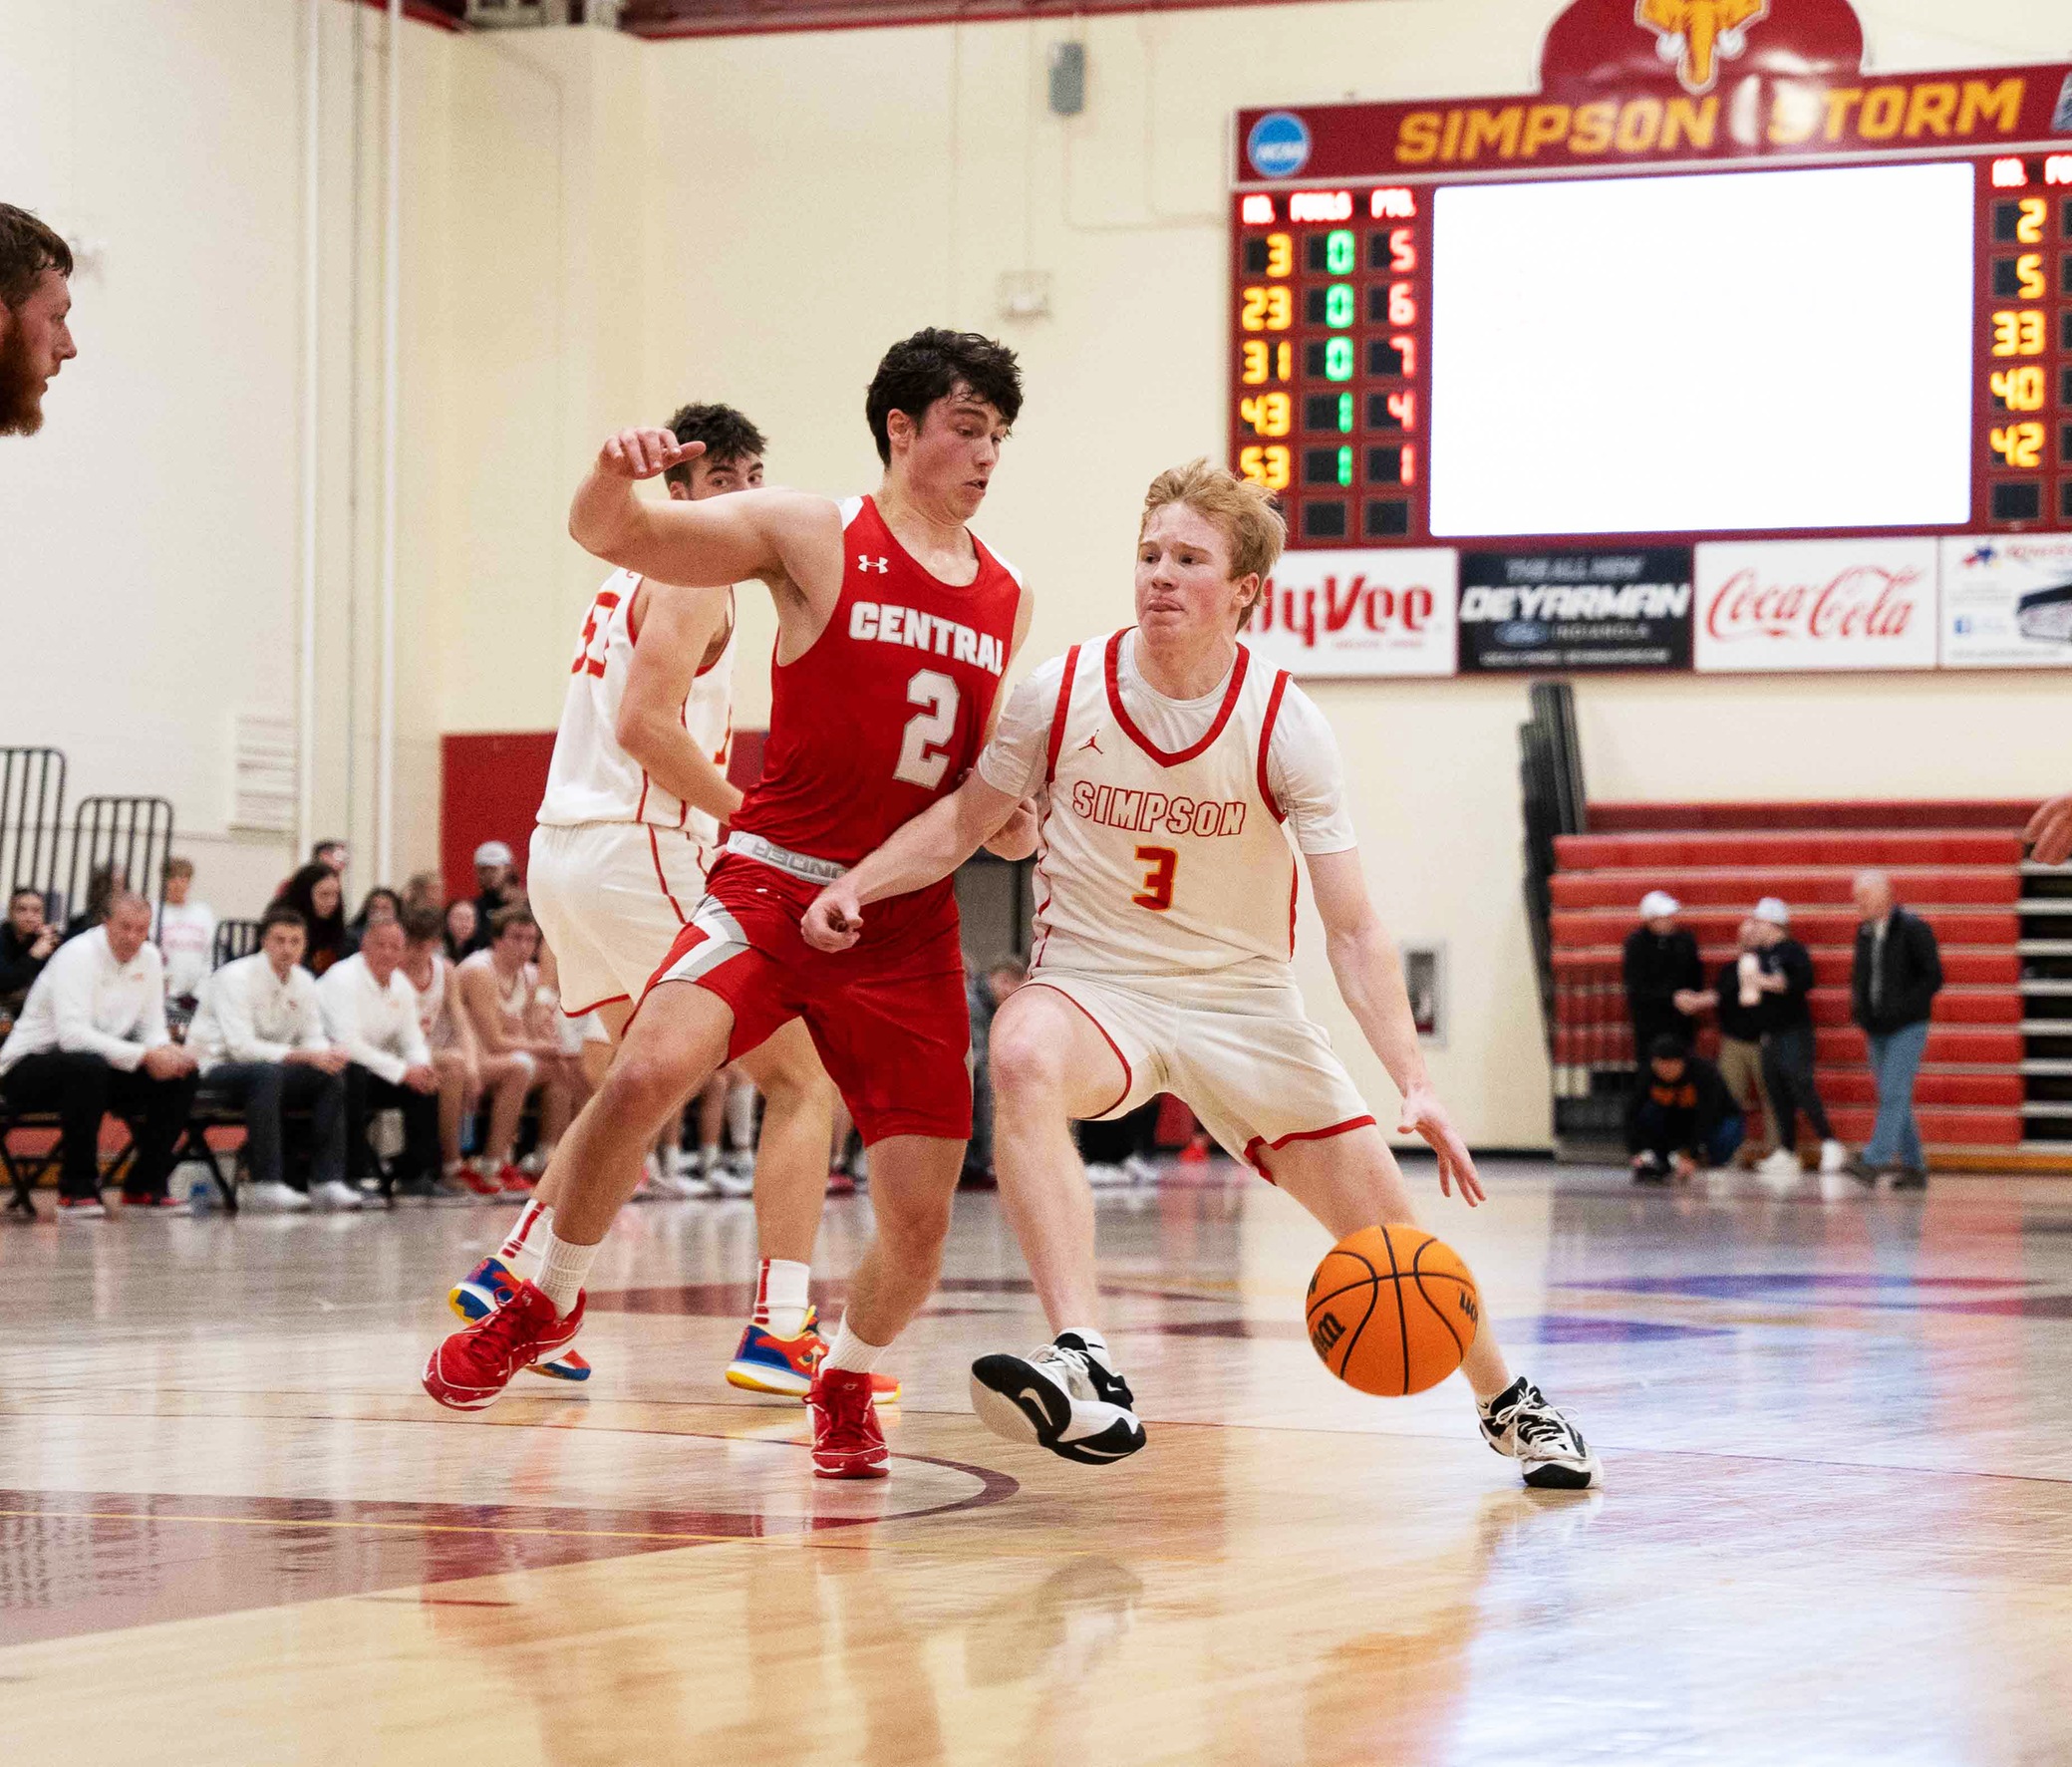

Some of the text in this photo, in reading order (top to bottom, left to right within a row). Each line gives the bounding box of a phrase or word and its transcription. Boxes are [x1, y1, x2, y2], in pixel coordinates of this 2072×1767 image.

[1396, 79, 2024, 163] SIMPSON STORM
[2016, 197, 2046, 243] 2
[1266, 226, 1417, 277] 3 0 5
[2016, 253, 2045, 299] 5
[1241, 281, 1417, 331] 23 0 6
[1991, 309, 2046, 357] 33
[1242, 335, 1417, 385] 31 0 7
[1989, 366, 2045, 412] 40
[1240, 392, 1416, 437] 43 1 4
[1240, 443, 1416, 489] 53 1 1
[1989, 422, 2045, 468] 42
[1459, 583, 1691, 622] DEYARMAN
[848, 601, 1004, 677] CENTRAL
[892, 668, 960, 791] 2
[1072, 780, 1246, 837] SIMPSON
[1131, 845, 1178, 912] 3
